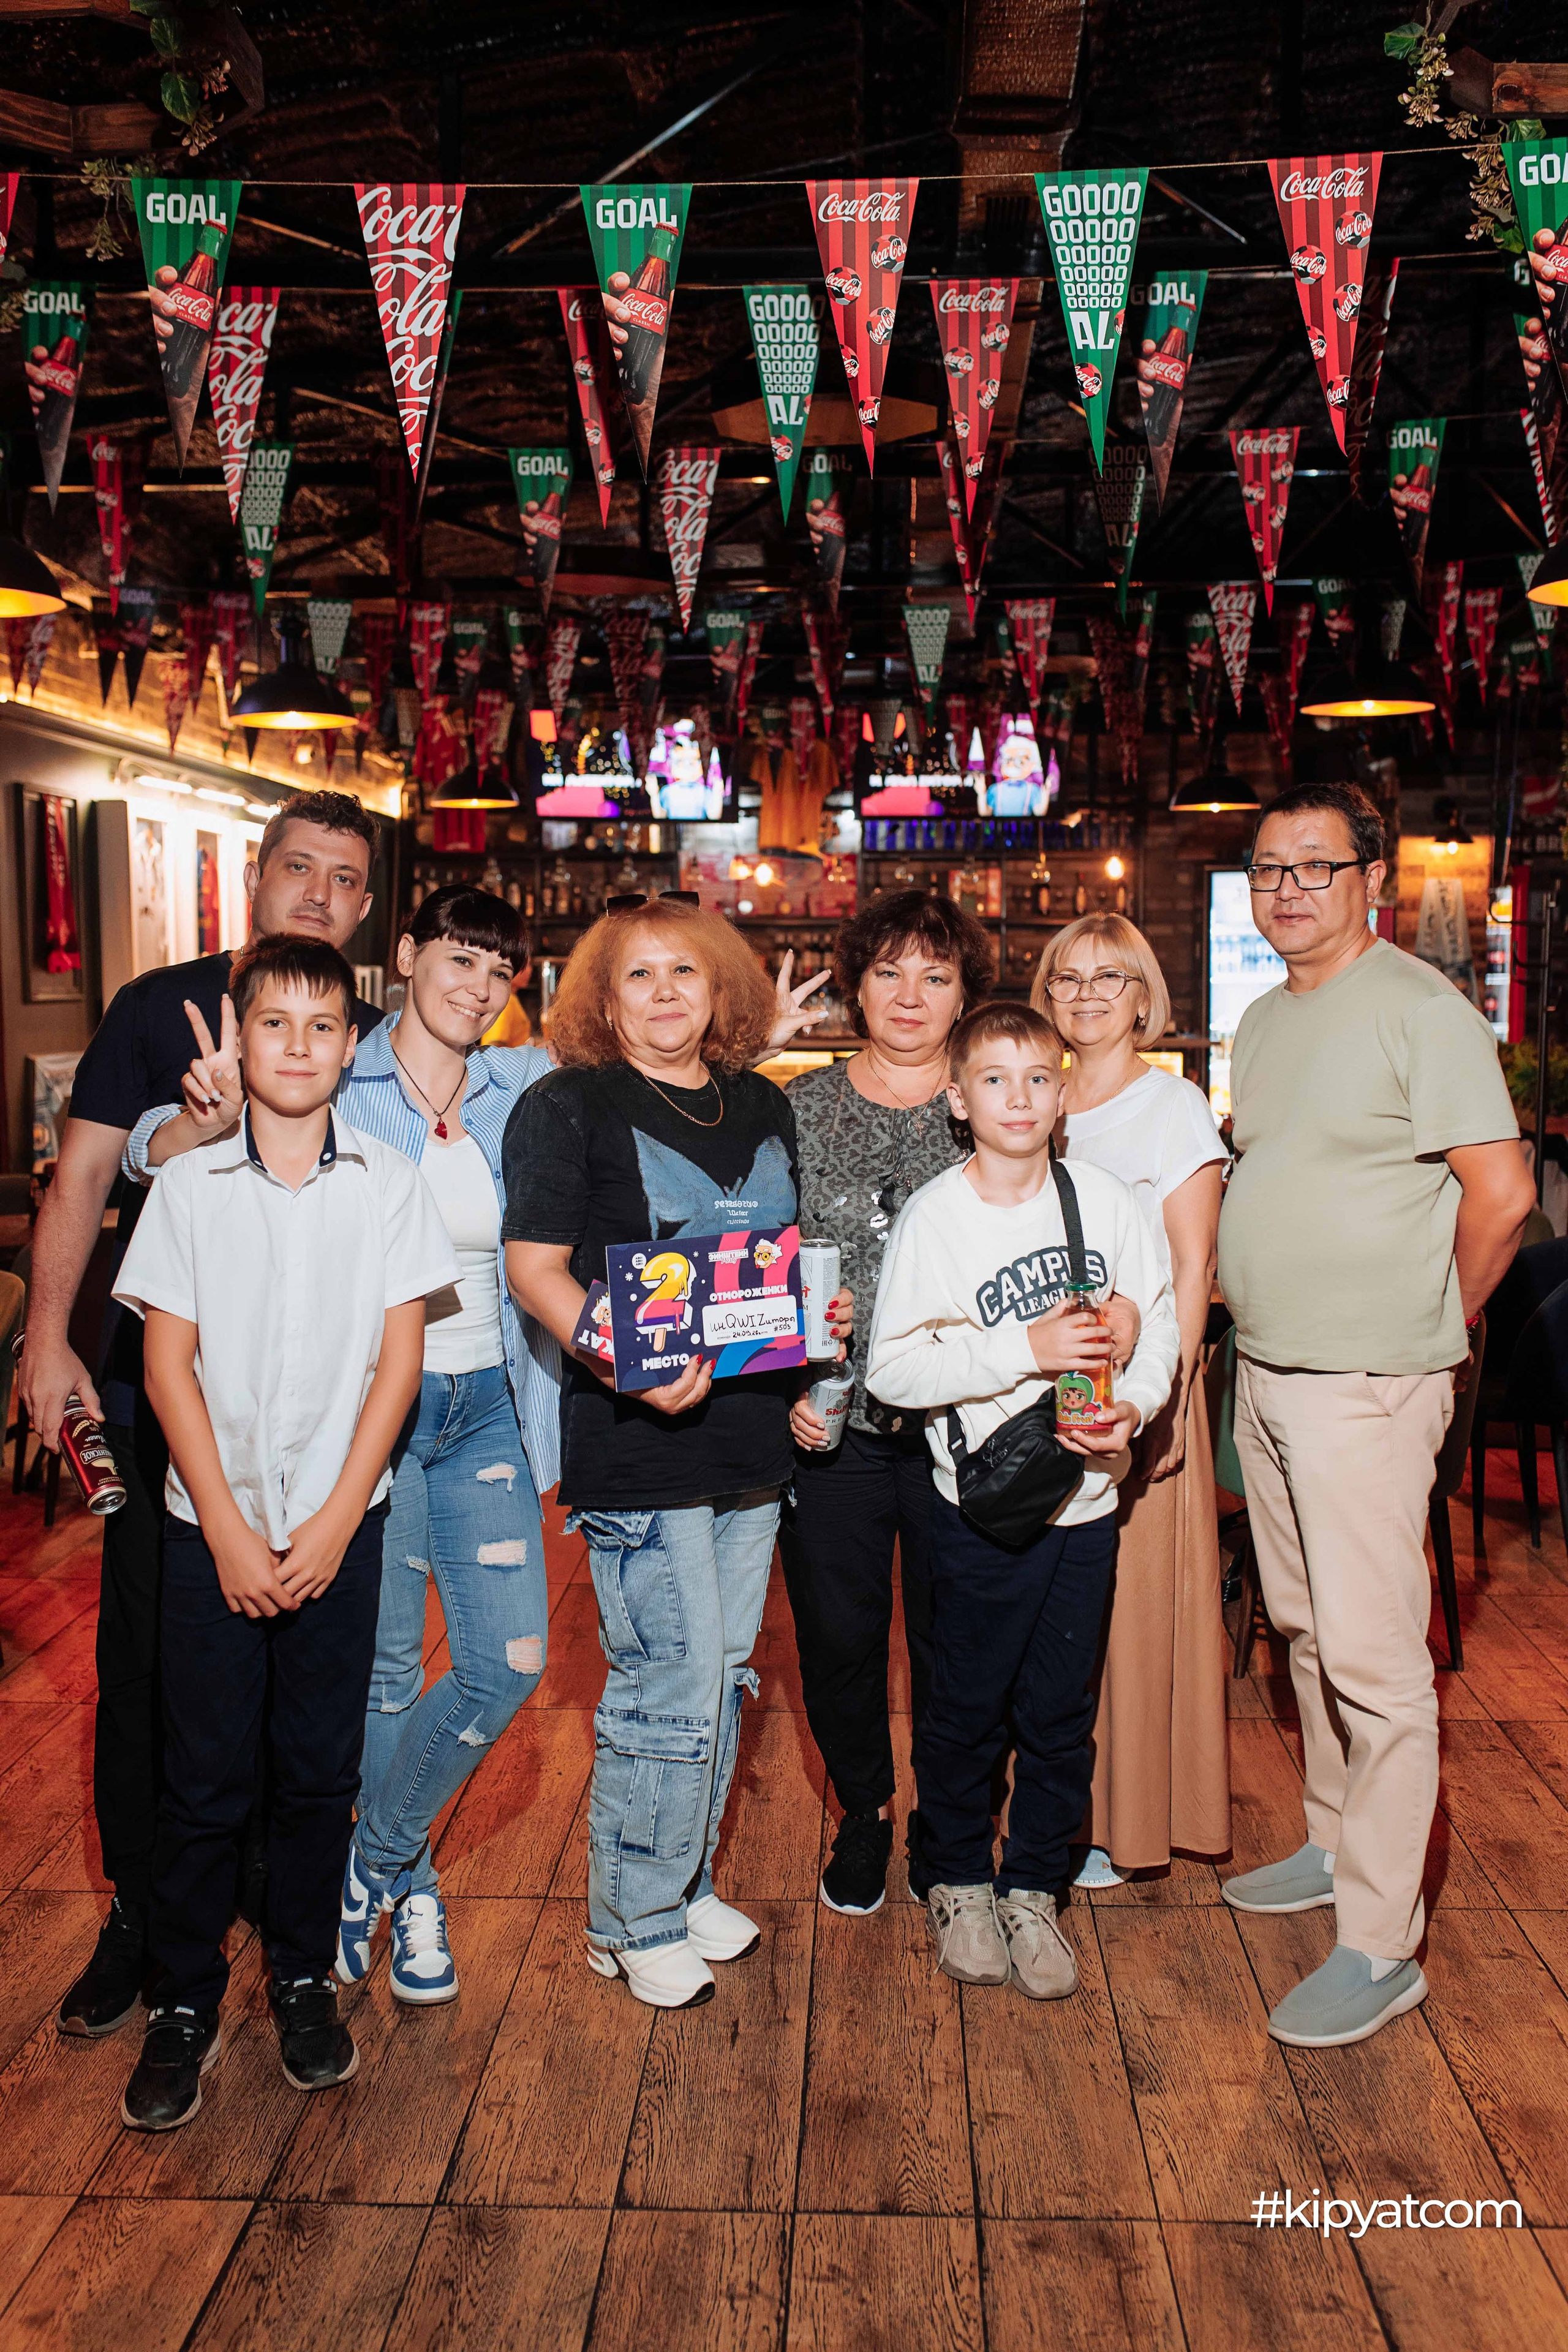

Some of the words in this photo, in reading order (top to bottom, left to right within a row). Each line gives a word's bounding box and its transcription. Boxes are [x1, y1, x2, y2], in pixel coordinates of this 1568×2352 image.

[1280, 166, 1370, 202] Coca-Cola
[146, 192, 227, 225] GOAL
[597, 197, 677, 228] GOAL
[818, 192, 906, 222] Coca-Cola
[1042, 182, 1141, 217] GOOOO
[1049, 217, 1136, 244] OOOOO
[1055, 244, 1131, 265] OOOOO
[1060, 265, 1128, 282] OOOOO
[939, 286, 1009, 312] Coca-Cola
[1063, 282, 1125, 296] OOOOO
[23, 290, 85, 315] GOAL
[621, 293, 667, 325] Coca-Cola
[1066, 296, 1122, 309] OOOOO
[633, 318, 651, 327] CLASSIC
[1069, 311, 1115, 350] AL
[767, 395, 804, 425] AL
[517, 456, 568, 476] GOAL
[246, 526, 274, 551] AL
[706, 612, 745, 628] GOAL
[635, 1252, 693, 1334] 2
[709, 1284, 788, 1302] ОТМОРОЖЕНКИ
[1017, 1287, 1066, 1316] LEAG
[642, 1353, 690, 1371] МЕСТО
